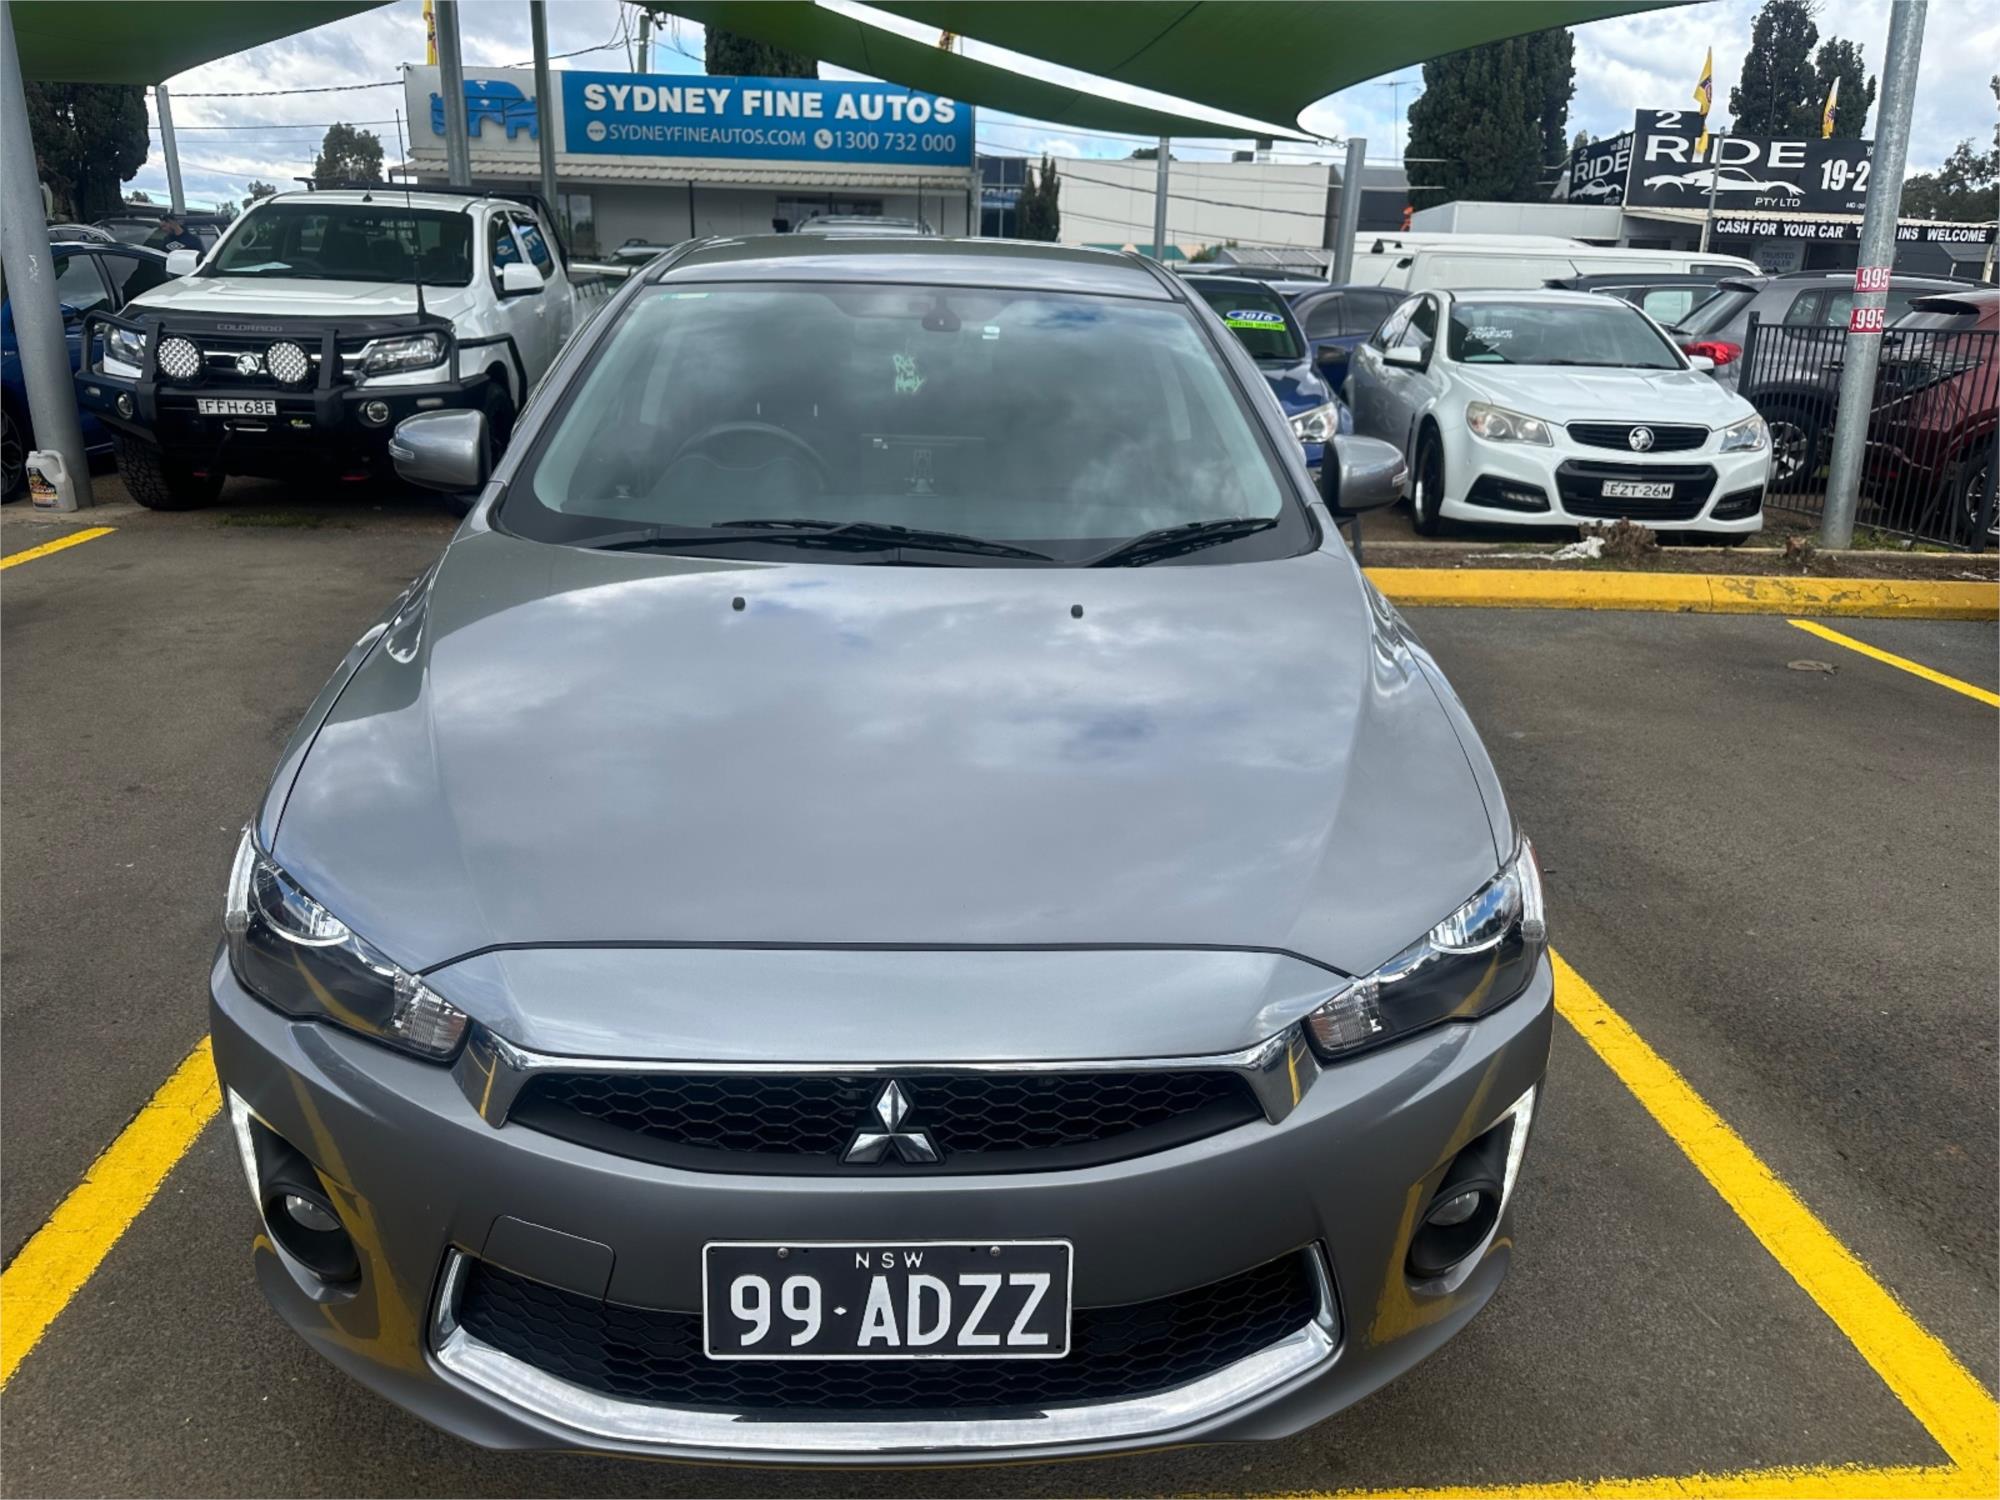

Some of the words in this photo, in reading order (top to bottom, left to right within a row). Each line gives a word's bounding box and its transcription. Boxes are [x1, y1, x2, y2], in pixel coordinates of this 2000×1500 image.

[584, 84, 731, 114] SYDNEY
[742, 90, 823, 118] FINE
[835, 95, 956, 124] AUTOS
[1655, 111, 1682, 128] 2
[608, 124, 806, 147] SYDNEYFINEAUTOS.COM
[834, 130, 880, 150] 1300
[884, 132, 918, 151] 732
[922, 133, 956, 153] 000
[1579, 148, 1588, 161] 2
[1644, 135, 1807, 168] RIDE
[1573, 149, 1630, 183] RIDE
[1754, 197, 1776, 207] PTY
[1779, 198, 1800, 208] LTD
[1716, 220, 1749, 235] CASH
[1752, 221, 1776, 236] FOR
[1783, 223, 1816, 238] YOUR
[1818, 224, 1843, 239] CAR
[1926, 229, 1987, 243] WELCOME
[1238, 311, 1273, 321] 2016
[217, 323, 283, 331] COLORADO
[855, 1252, 923, 1268] NSW
